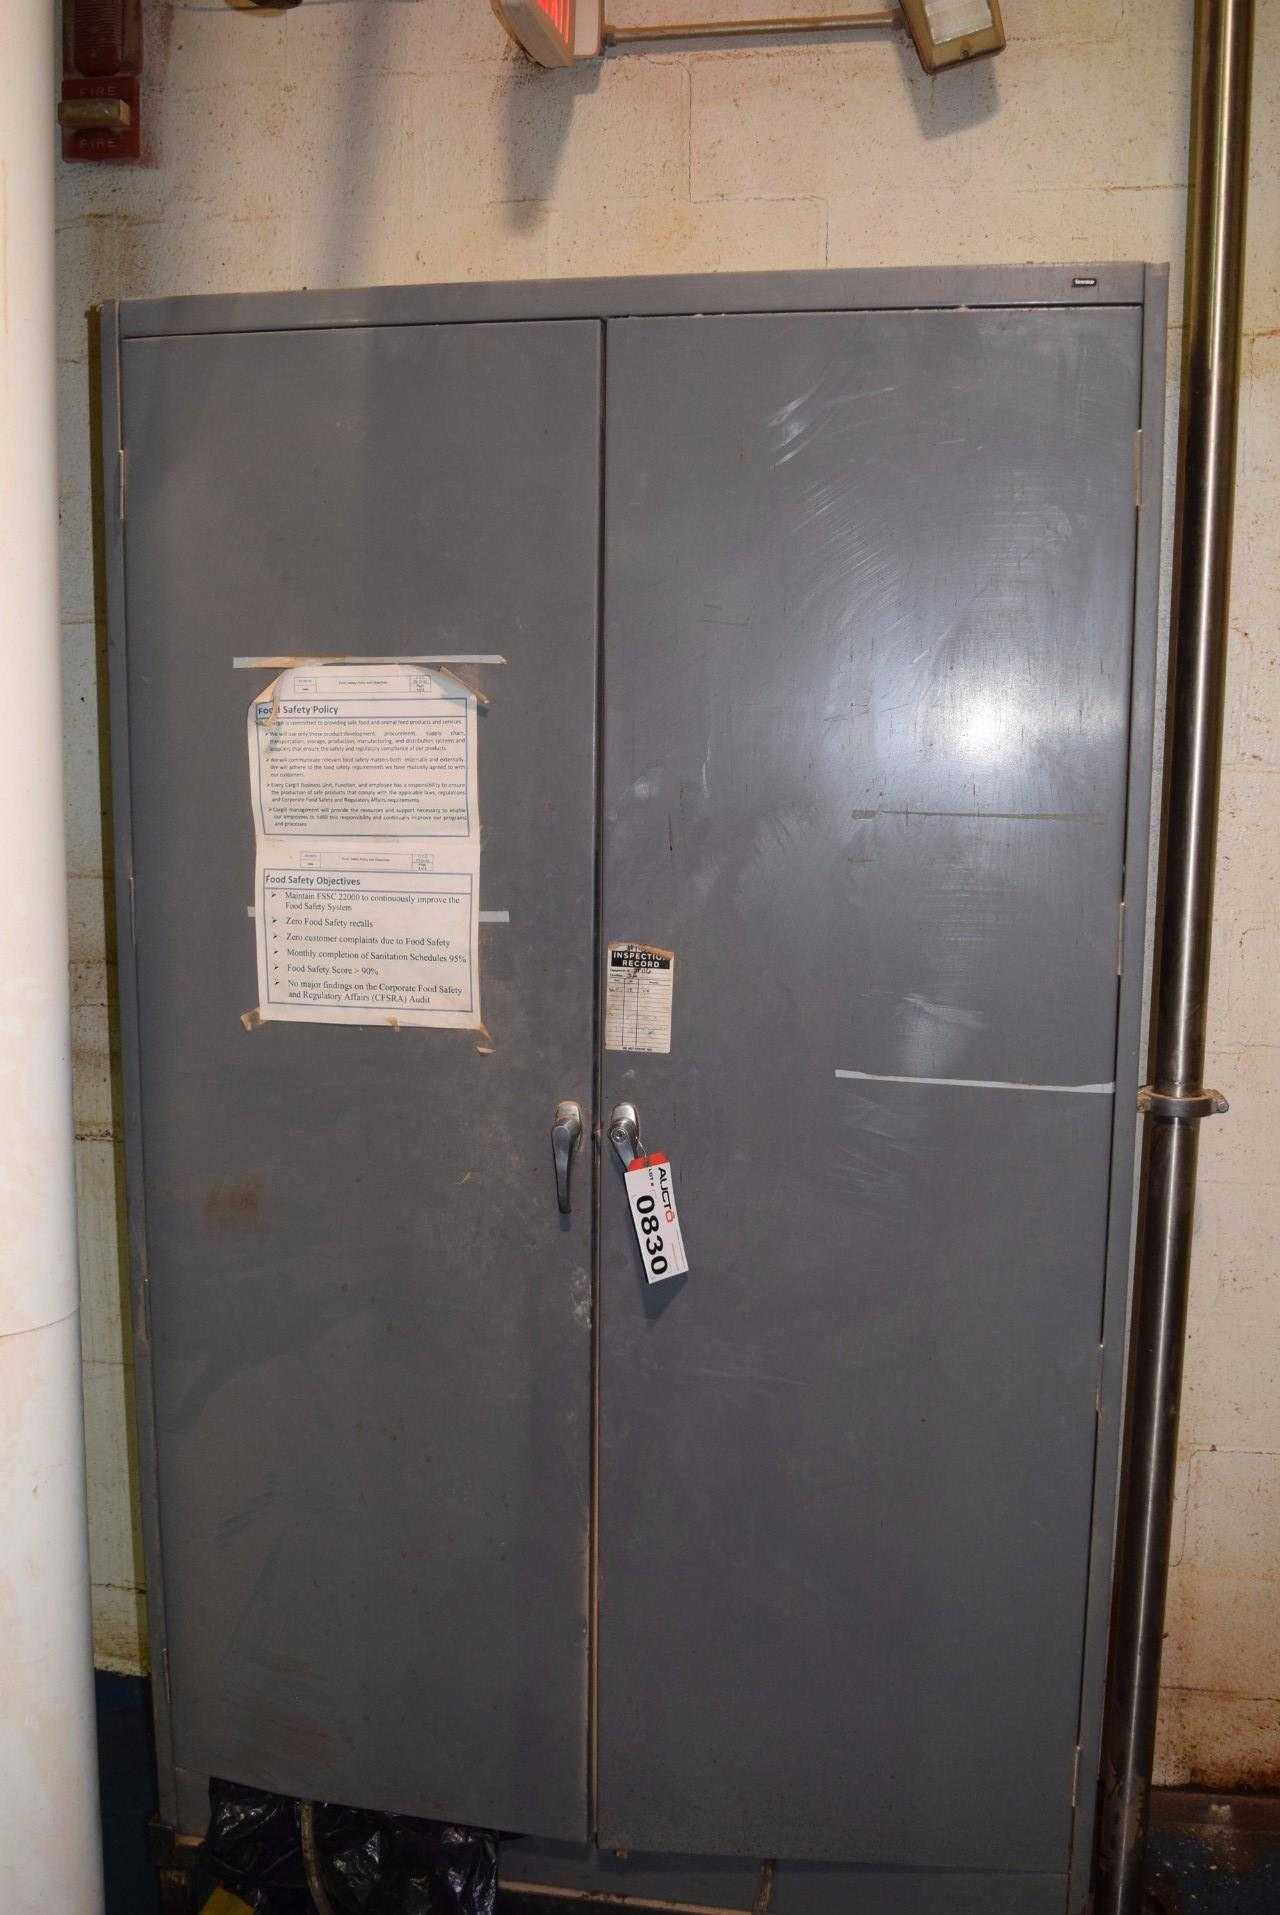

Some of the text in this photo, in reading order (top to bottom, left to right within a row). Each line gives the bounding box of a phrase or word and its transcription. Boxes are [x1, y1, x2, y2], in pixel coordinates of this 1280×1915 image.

[283, 705, 311, 715] Safety
[313, 705, 339, 715] Policy
[265, 876, 361, 887] Food Safety Objectives
[285, 892, 315, 900] Maintain
[317, 893, 336, 901] FSSC
[370, 896, 415, 905] continuously
[417, 897, 447, 905] improve
[285, 902, 352, 912] Food Safety System
[286, 917, 303, 925] Zero
[304, 918, 323, 926] Food
[324, 918, 348, 929] Safety
[286, 933, 303, 941] Zero
[339, 935, 379, 945] complaints
[405, 937, 425, 946] Food
[426, 938, 450, 949] Safety
[287, 949, 316, 959] Monthly
[319, 950, 359, 959] completion
[370, 952, 408, 960] Sanitation
[410, 953, 447, 962] Schedules
[449, 955, 467, 963] 95%
[613, 951, 668, 961] INSPECTIO
[287, 964, 305, 972] Food
[307, 965, 330, 975] Safety
[332, 966, 353, 974] Score
[361, 967, 379, 975] 90%
[622, 959, 660, 968] RECORD
[288, 980, 299, 988] No
[300, 981, 321, 990] major
[323, 981, 353, 991] findings
[379, 984, 417, 994] Corporate
[418, 985, 437, 993] Food
[438, 986, 463, 997] Safety
[303, 991, 341, 1001] Regulatory
[344, 993, 370, 1001] Affairs
[371, 994, 407, 1004] (CFSRA)
[409, 996, 431, 1004] Audit
[636, 1195, 669, 1275] 0830
